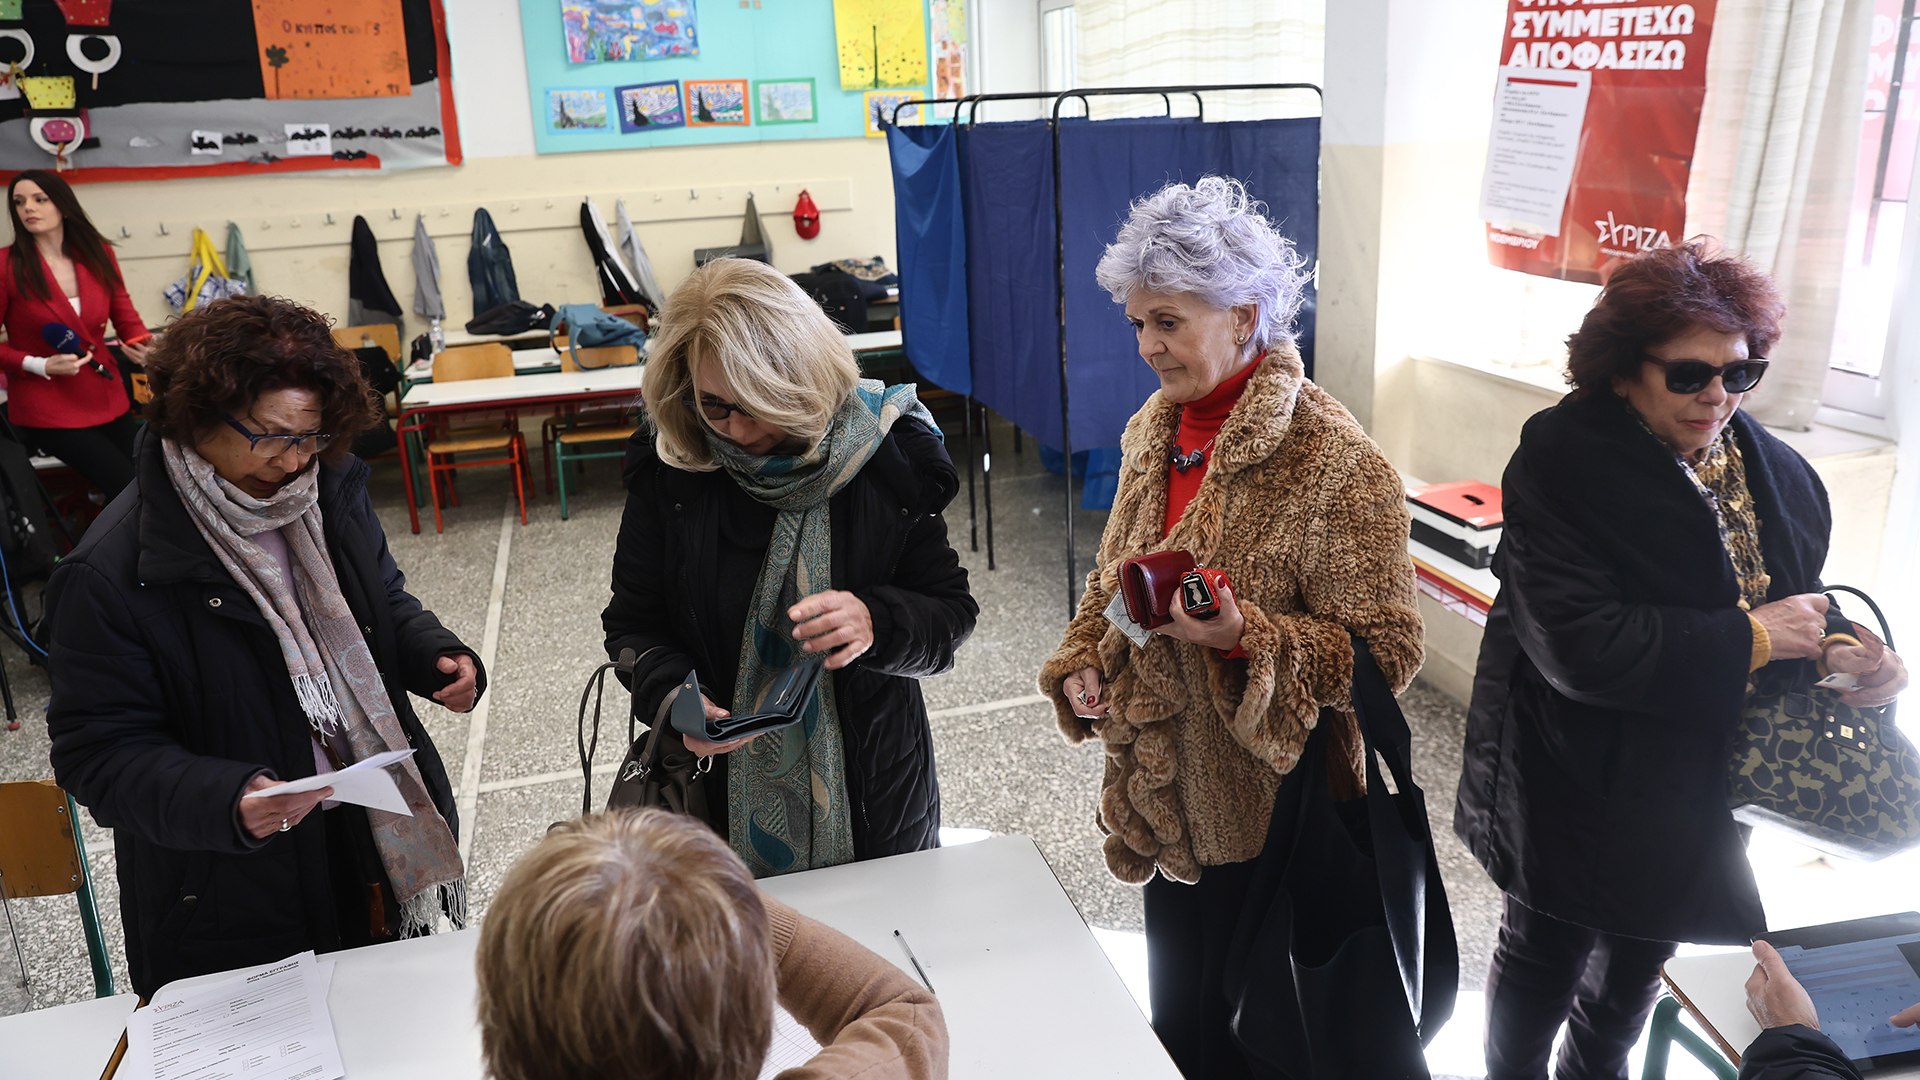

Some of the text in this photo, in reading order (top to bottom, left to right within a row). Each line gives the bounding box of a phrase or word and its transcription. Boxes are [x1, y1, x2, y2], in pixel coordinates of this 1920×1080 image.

[1510, 4, 1695, 38] ΣΥΜΜΕΤΕΧΩ
[1506, 39, 1686, 70] ΑΠΟΦΑΣΙΖΩ
[1594, 210, 1674, 252] ΣΥΡΙΖΑ
[153, 1000, 185, 1013] ΣΥΡΙΖΑ
